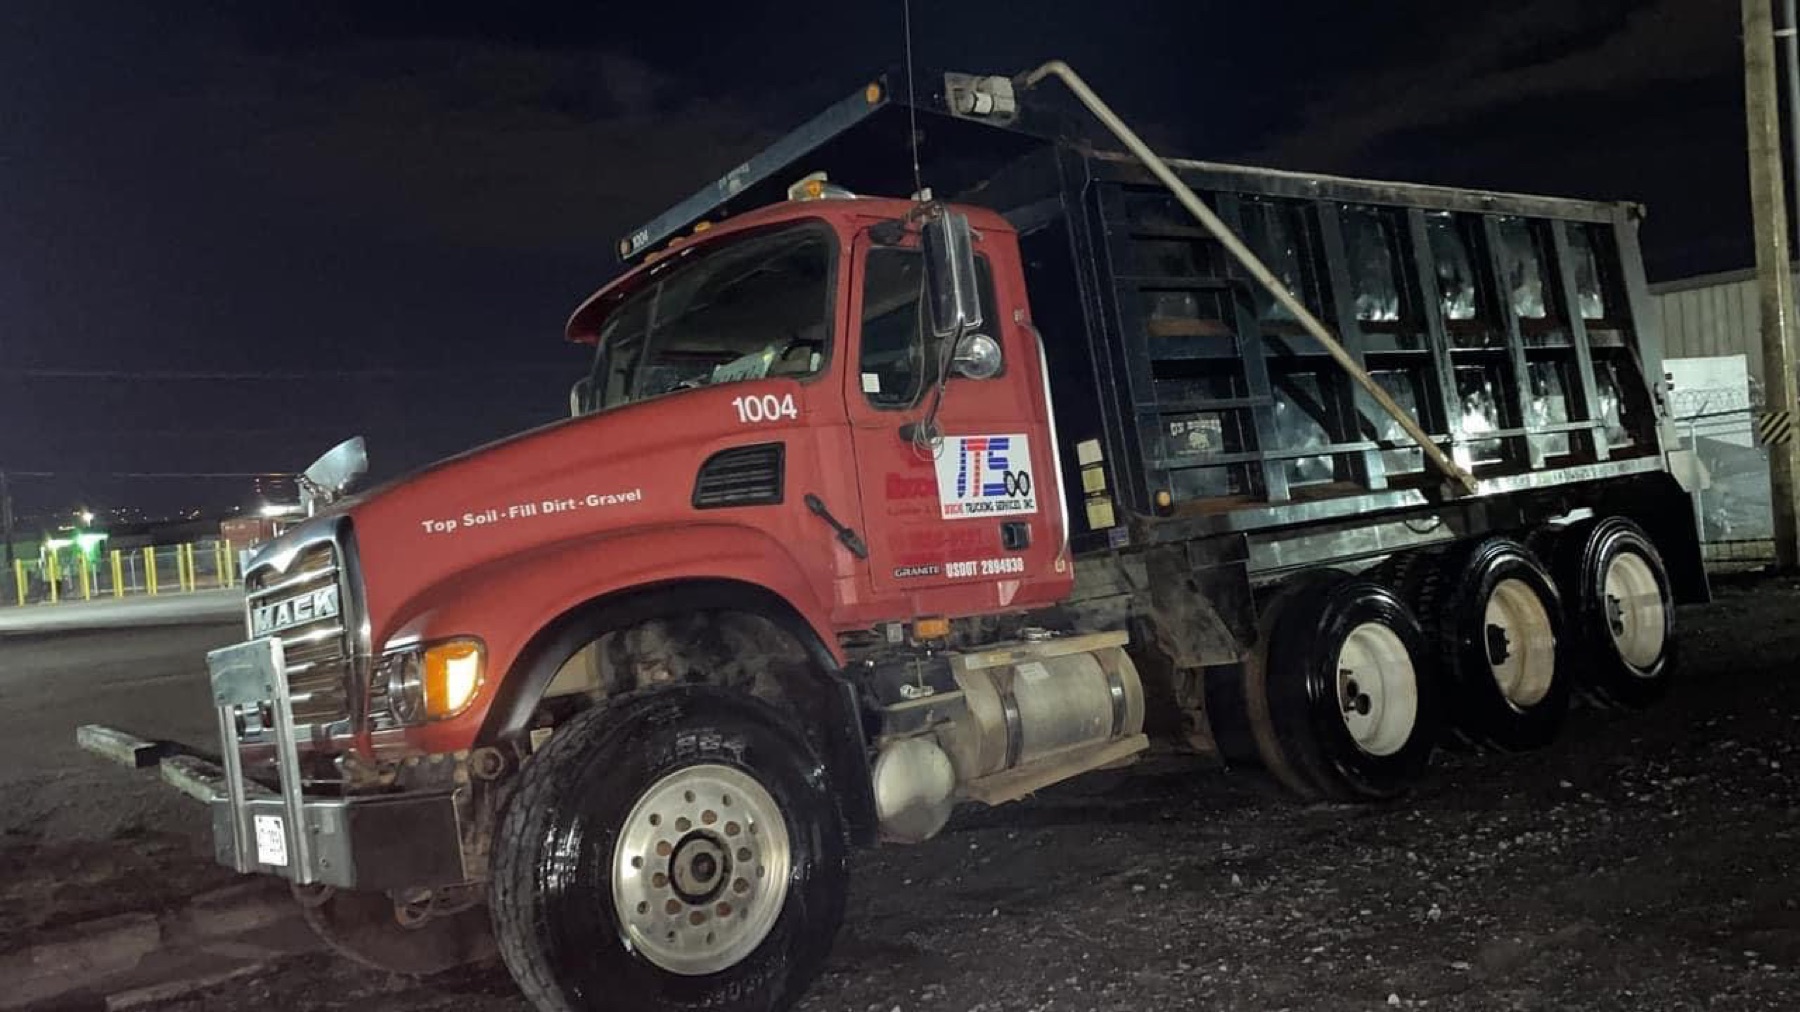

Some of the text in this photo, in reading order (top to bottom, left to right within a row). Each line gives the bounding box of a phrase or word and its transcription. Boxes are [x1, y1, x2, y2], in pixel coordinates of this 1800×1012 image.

[731, 393, 798, 423] 1004
[421, 520, 457, 534] Top
[463, 509, 498, 527] Soil
[509, 502, 537, 519] Fill
[542, 498, 577, 514] Dirt
[585, 488, 642, 507] Gravel
[945, 561, 978, 579] USDOT
[253, 585, 337, 632] MACK
